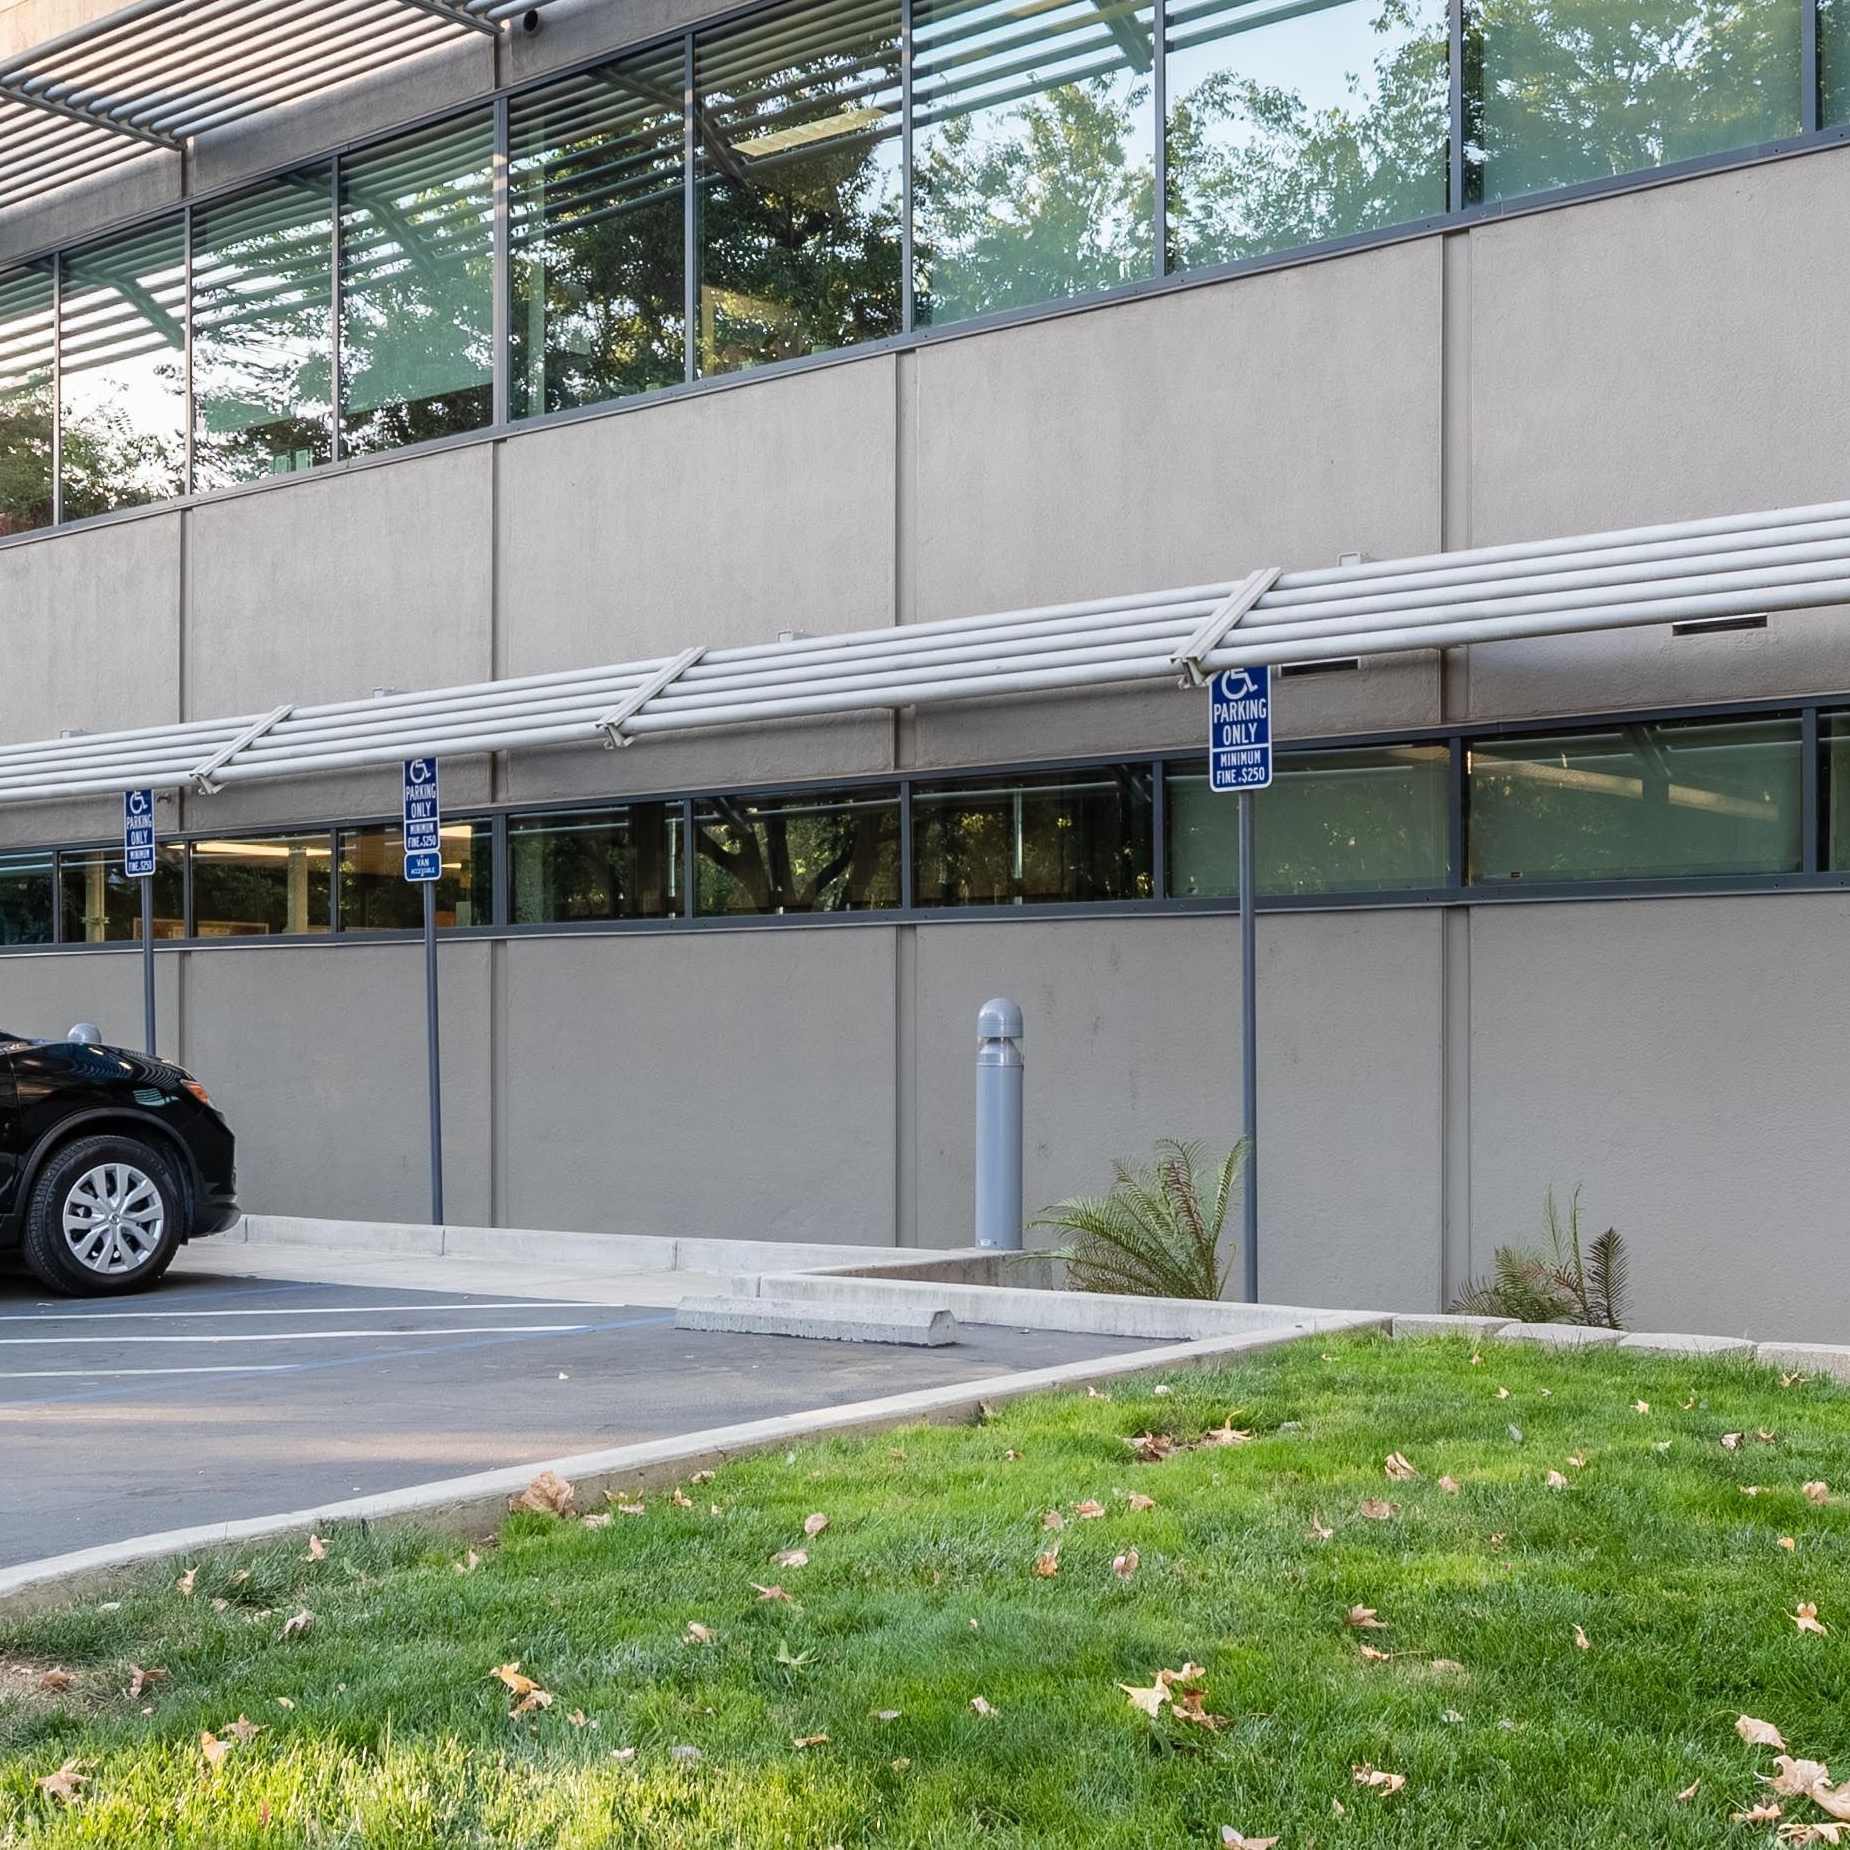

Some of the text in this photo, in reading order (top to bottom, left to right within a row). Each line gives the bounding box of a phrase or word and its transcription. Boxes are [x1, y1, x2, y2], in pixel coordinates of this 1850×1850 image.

[1213, 698, 1267, 724] PARKING
[1222, 722, 1257, 746] ONLY
[1220, 750, 1261, 767] MINIMUM
[1216, 766, 1265, 785] FINE $250
[405, 783, 436, 802] PARKING
[411, 801, 431, 819] ONLY
[126, 813, 152, 830] PARKING
[410, 822, 434, 835] MINIMUM
[130, 829, 148, 845] ONLY
[407, 834, 437, 848] FINE $250
[416, 858, 430, 867] VAN
